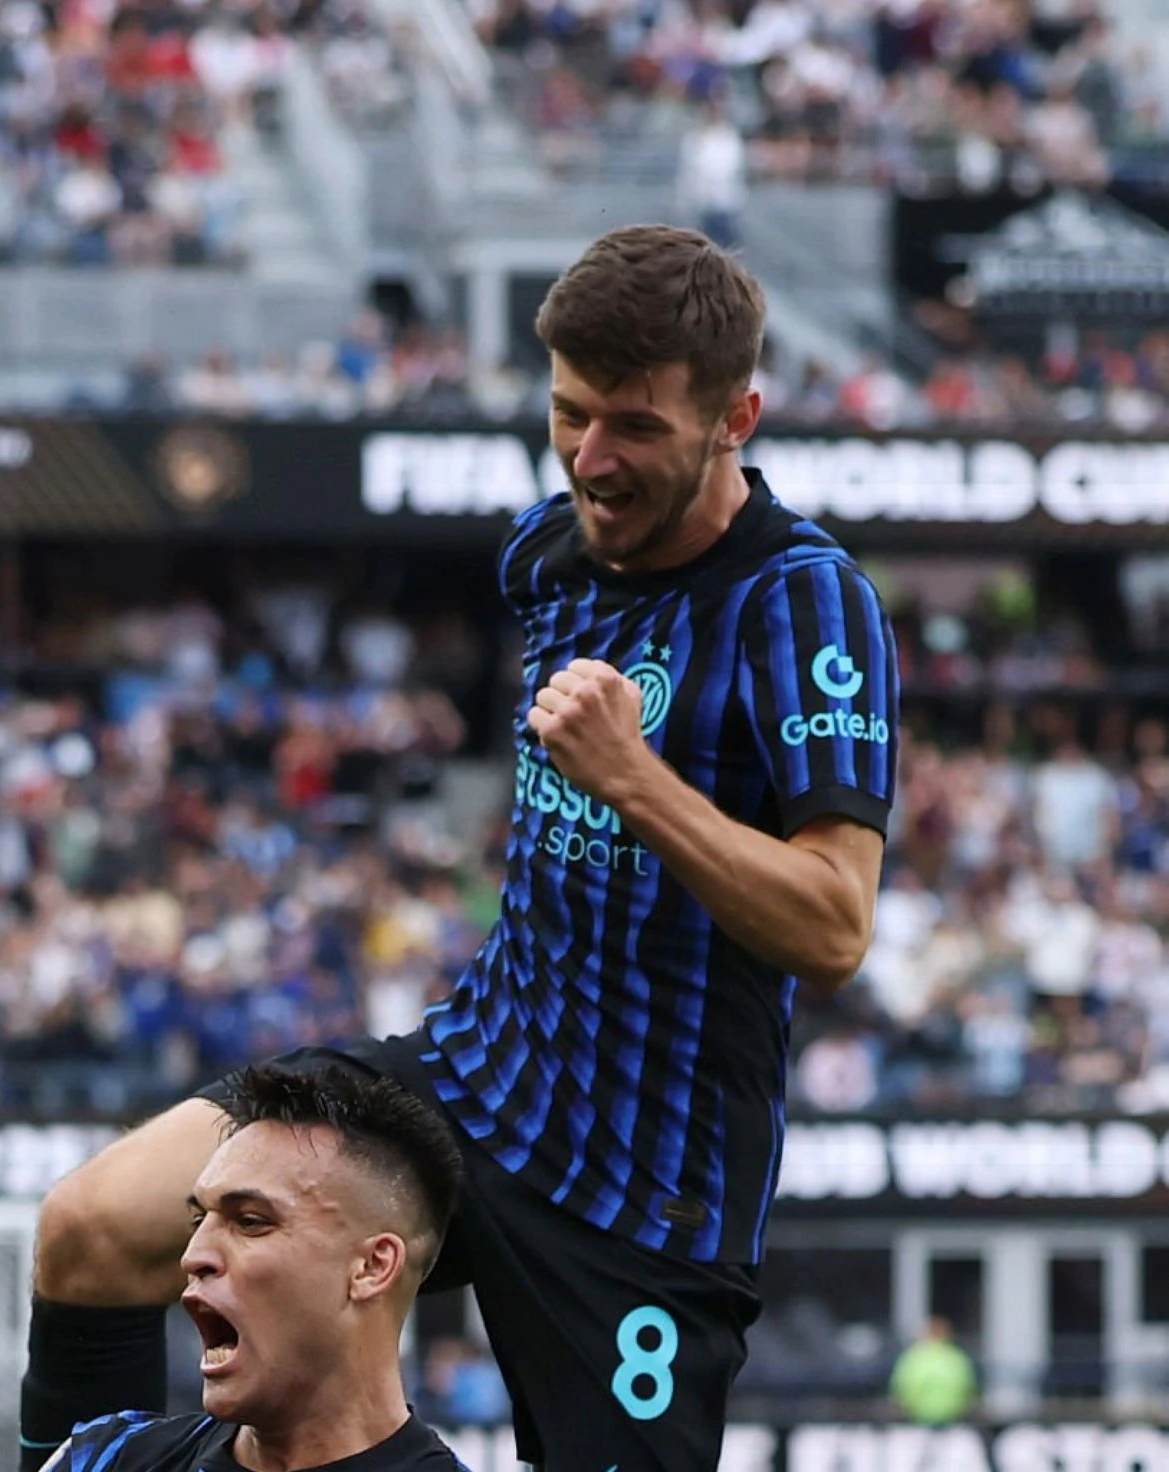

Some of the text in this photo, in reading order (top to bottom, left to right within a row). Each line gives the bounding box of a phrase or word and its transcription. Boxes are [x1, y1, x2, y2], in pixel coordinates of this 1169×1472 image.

[361, 431, 539, 517] FIFA
[781, 708, 889, 746] Gate.io
[538, 826, 648, 876] .sport
[889, 1121, 1159, 1199] WORLD
[611, 1305, 678, 1420] 8
